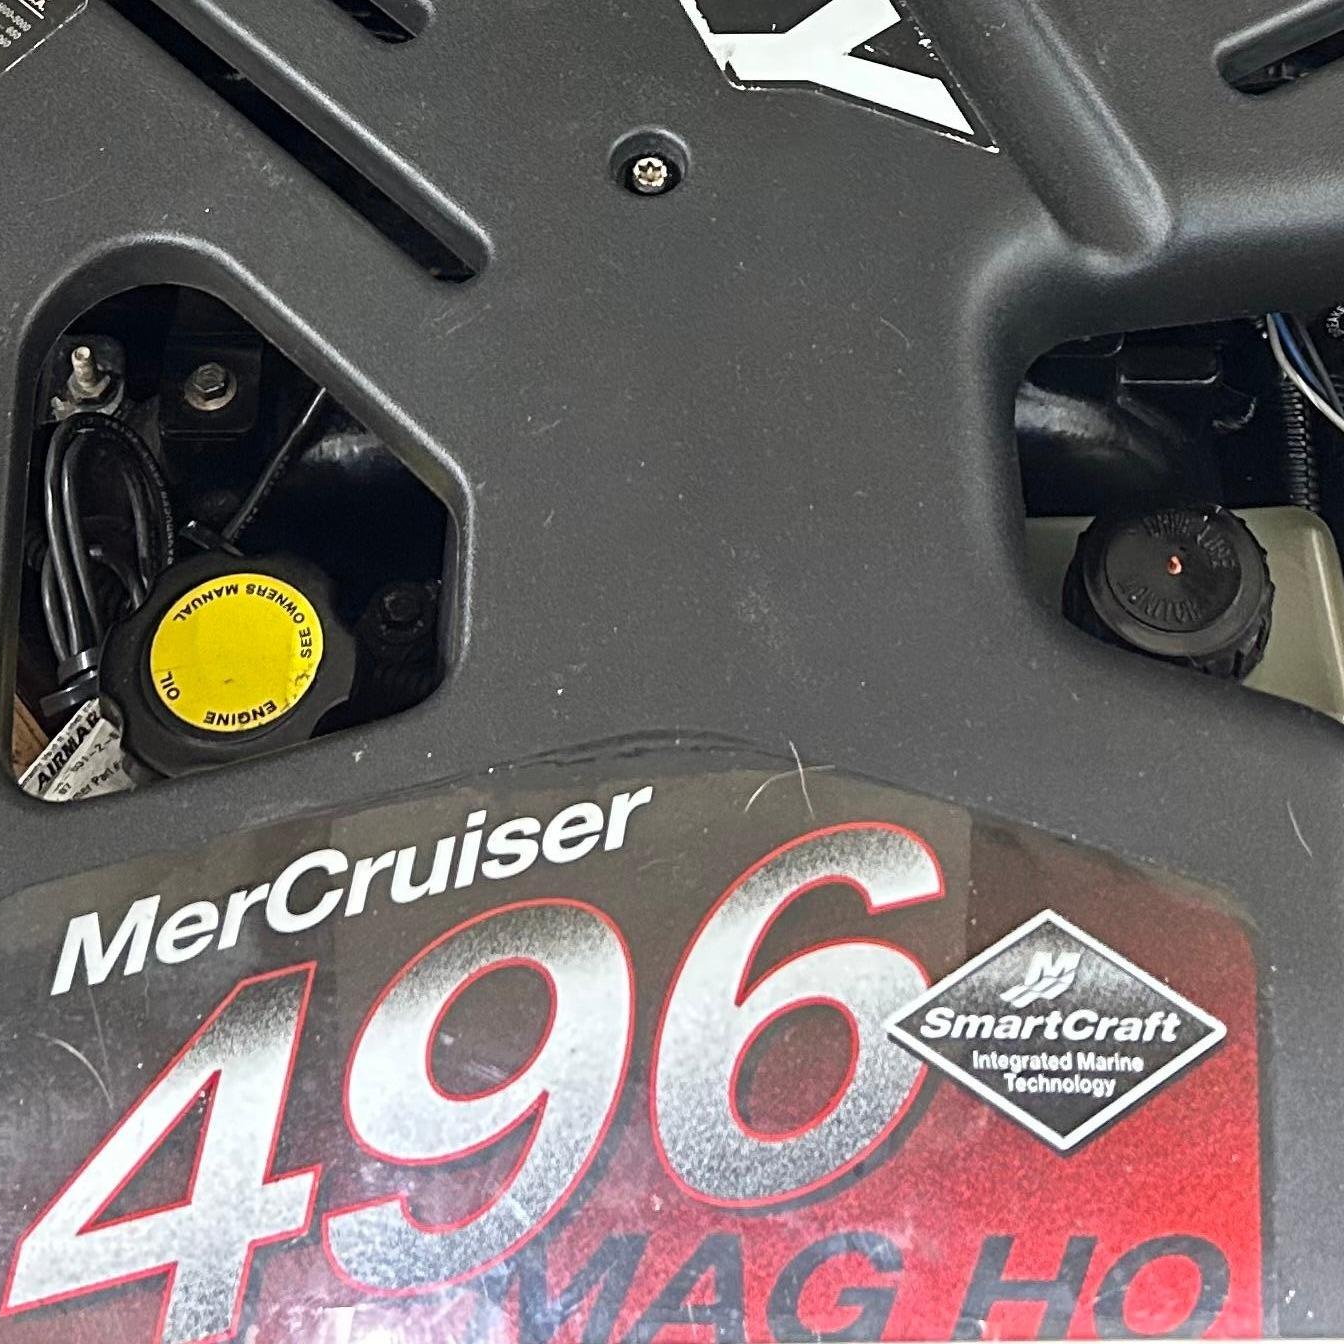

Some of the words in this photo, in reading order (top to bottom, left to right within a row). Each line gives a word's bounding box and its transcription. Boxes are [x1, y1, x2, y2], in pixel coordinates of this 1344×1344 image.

[173, 584, 239, 622] MANUAL
[245, 583, 305, 624] OWNERS
[299, 627, 312, 659] SEE
[160, 671, 181, 701] OIL
[203, 700, 278, 726] ENGINE
[50, 785, 653, 996] MerCruiser
[920, 1006, 1182, 1043] SmartCraft
[972, 1050, 1073, 1073] Integrated
[1077, 1052, 1144, 1073] Marine
[1004, 1073, 1117, 1097] Technology
[506, 1232, 905, 1343] MAG
[956, 1232, 1232, 1342] HO
